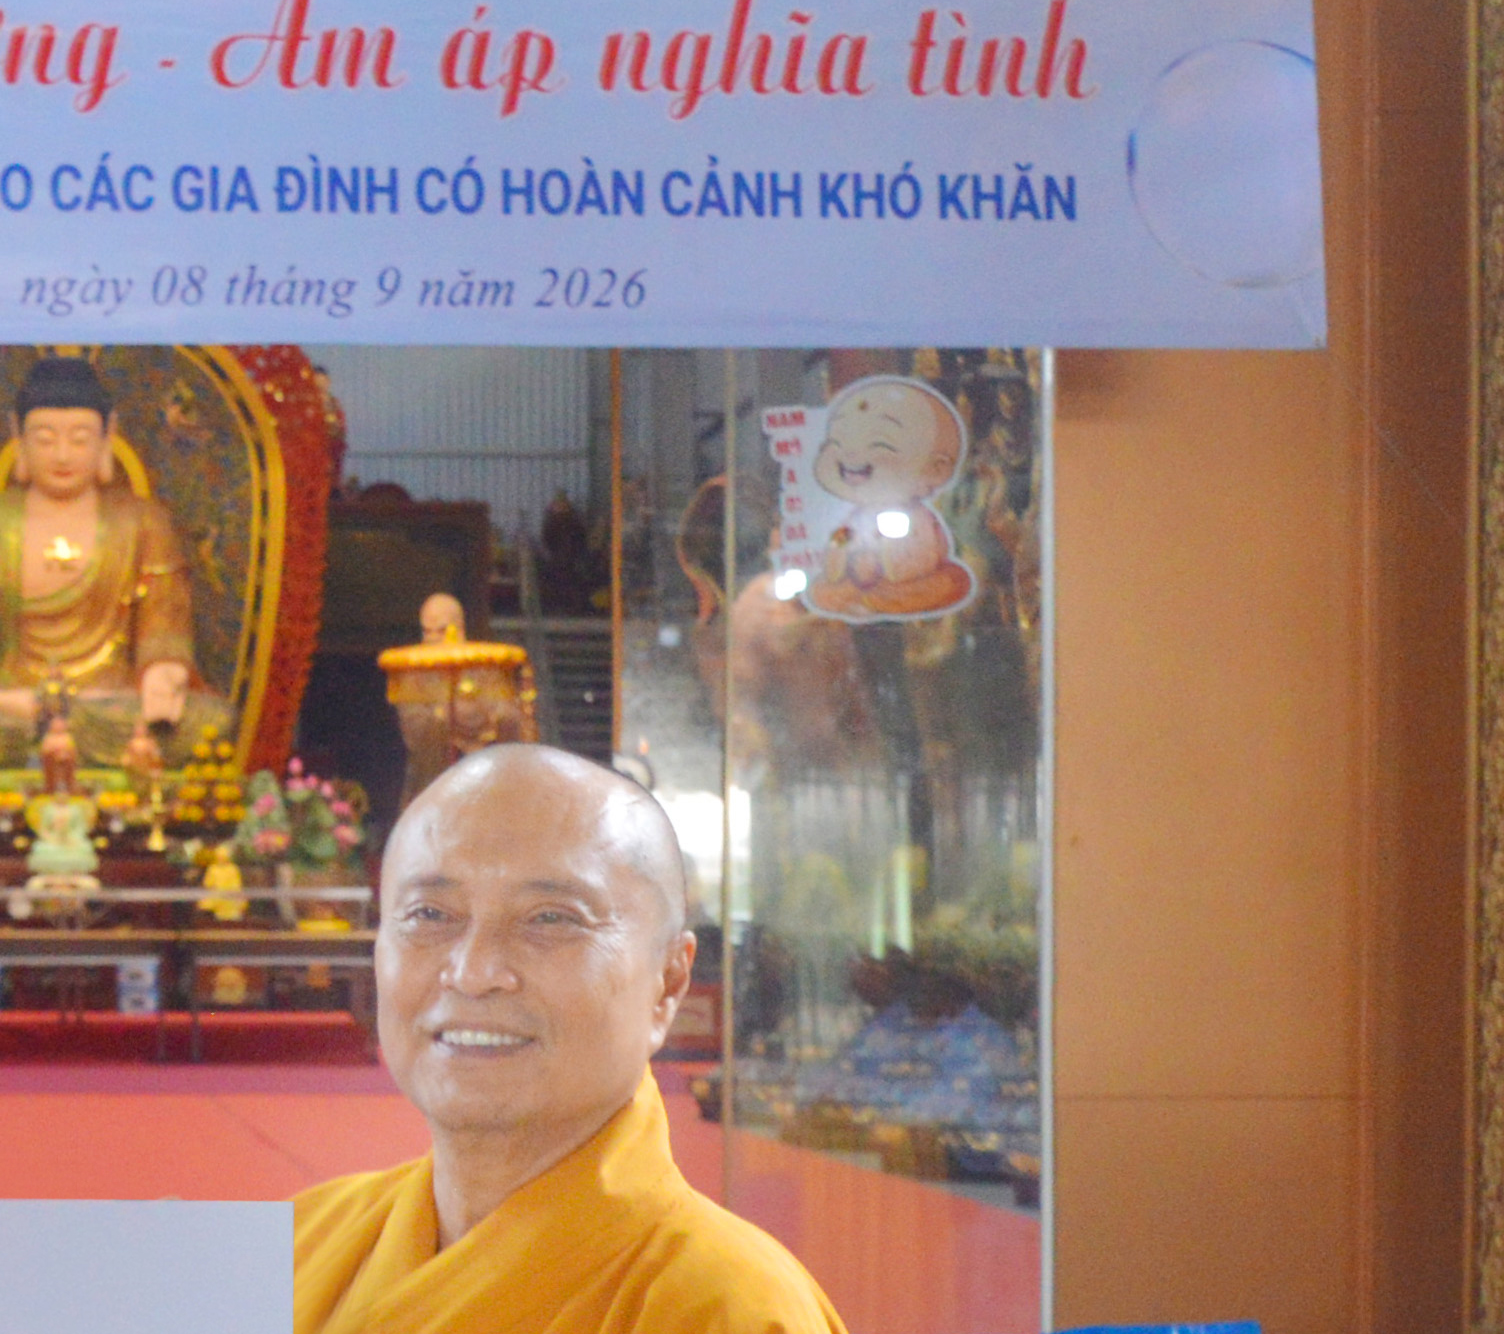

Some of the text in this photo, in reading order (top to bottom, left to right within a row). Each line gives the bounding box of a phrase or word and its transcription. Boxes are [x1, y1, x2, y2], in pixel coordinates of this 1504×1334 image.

[440, 6, 556, 117] áp
[49, 151, 156, 213] CÁC
[171, 163, 260, 214] GIA
[273, 153, 399, 214] ĐÌNH
[414, 155, 486, 216] CÓ
[500, 157, 646, 217] HOÀN
[660, 154, 803, 218] CẢNH
[818, 160, 924, 220] KHÓ
[937, 163, 1078, 222] KHĂN
[18, 262, 136, 320] ngày
[150, 264, 209, 305] 08
[224, 263, 358, 319] tháng
[376, 265, 403, 306] 9
[418, 269, 516, 309] năm
[534, 266, 647, 310] 2026
